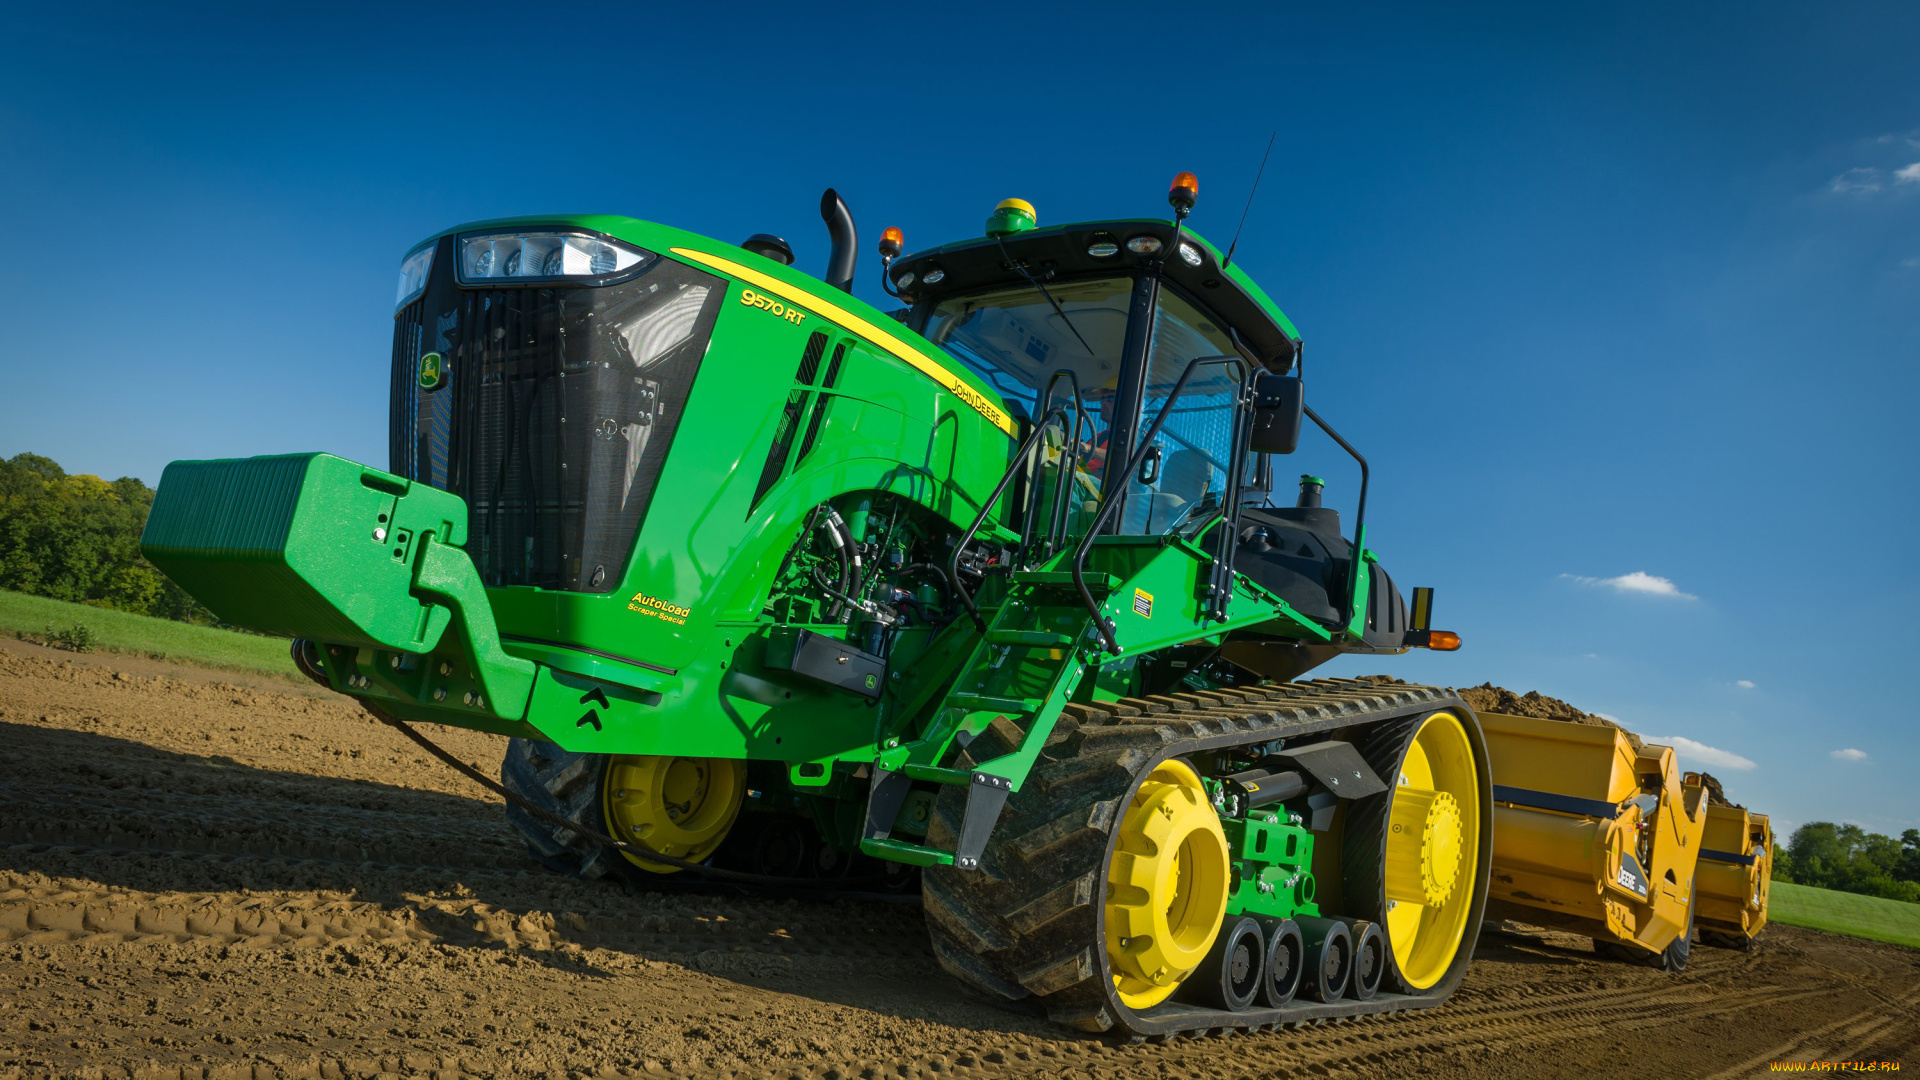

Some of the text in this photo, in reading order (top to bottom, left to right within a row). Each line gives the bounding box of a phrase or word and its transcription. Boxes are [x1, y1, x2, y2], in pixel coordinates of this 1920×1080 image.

[741, 289, 806, 326] 9570 RT
[951, 380, 1001, 425] JOHN DEERE
[628, 603, 686, 626] Scraper Special
[630, 592, 691, 618] AutoLoad
[1617, 865, 1636, 891] DEERE
